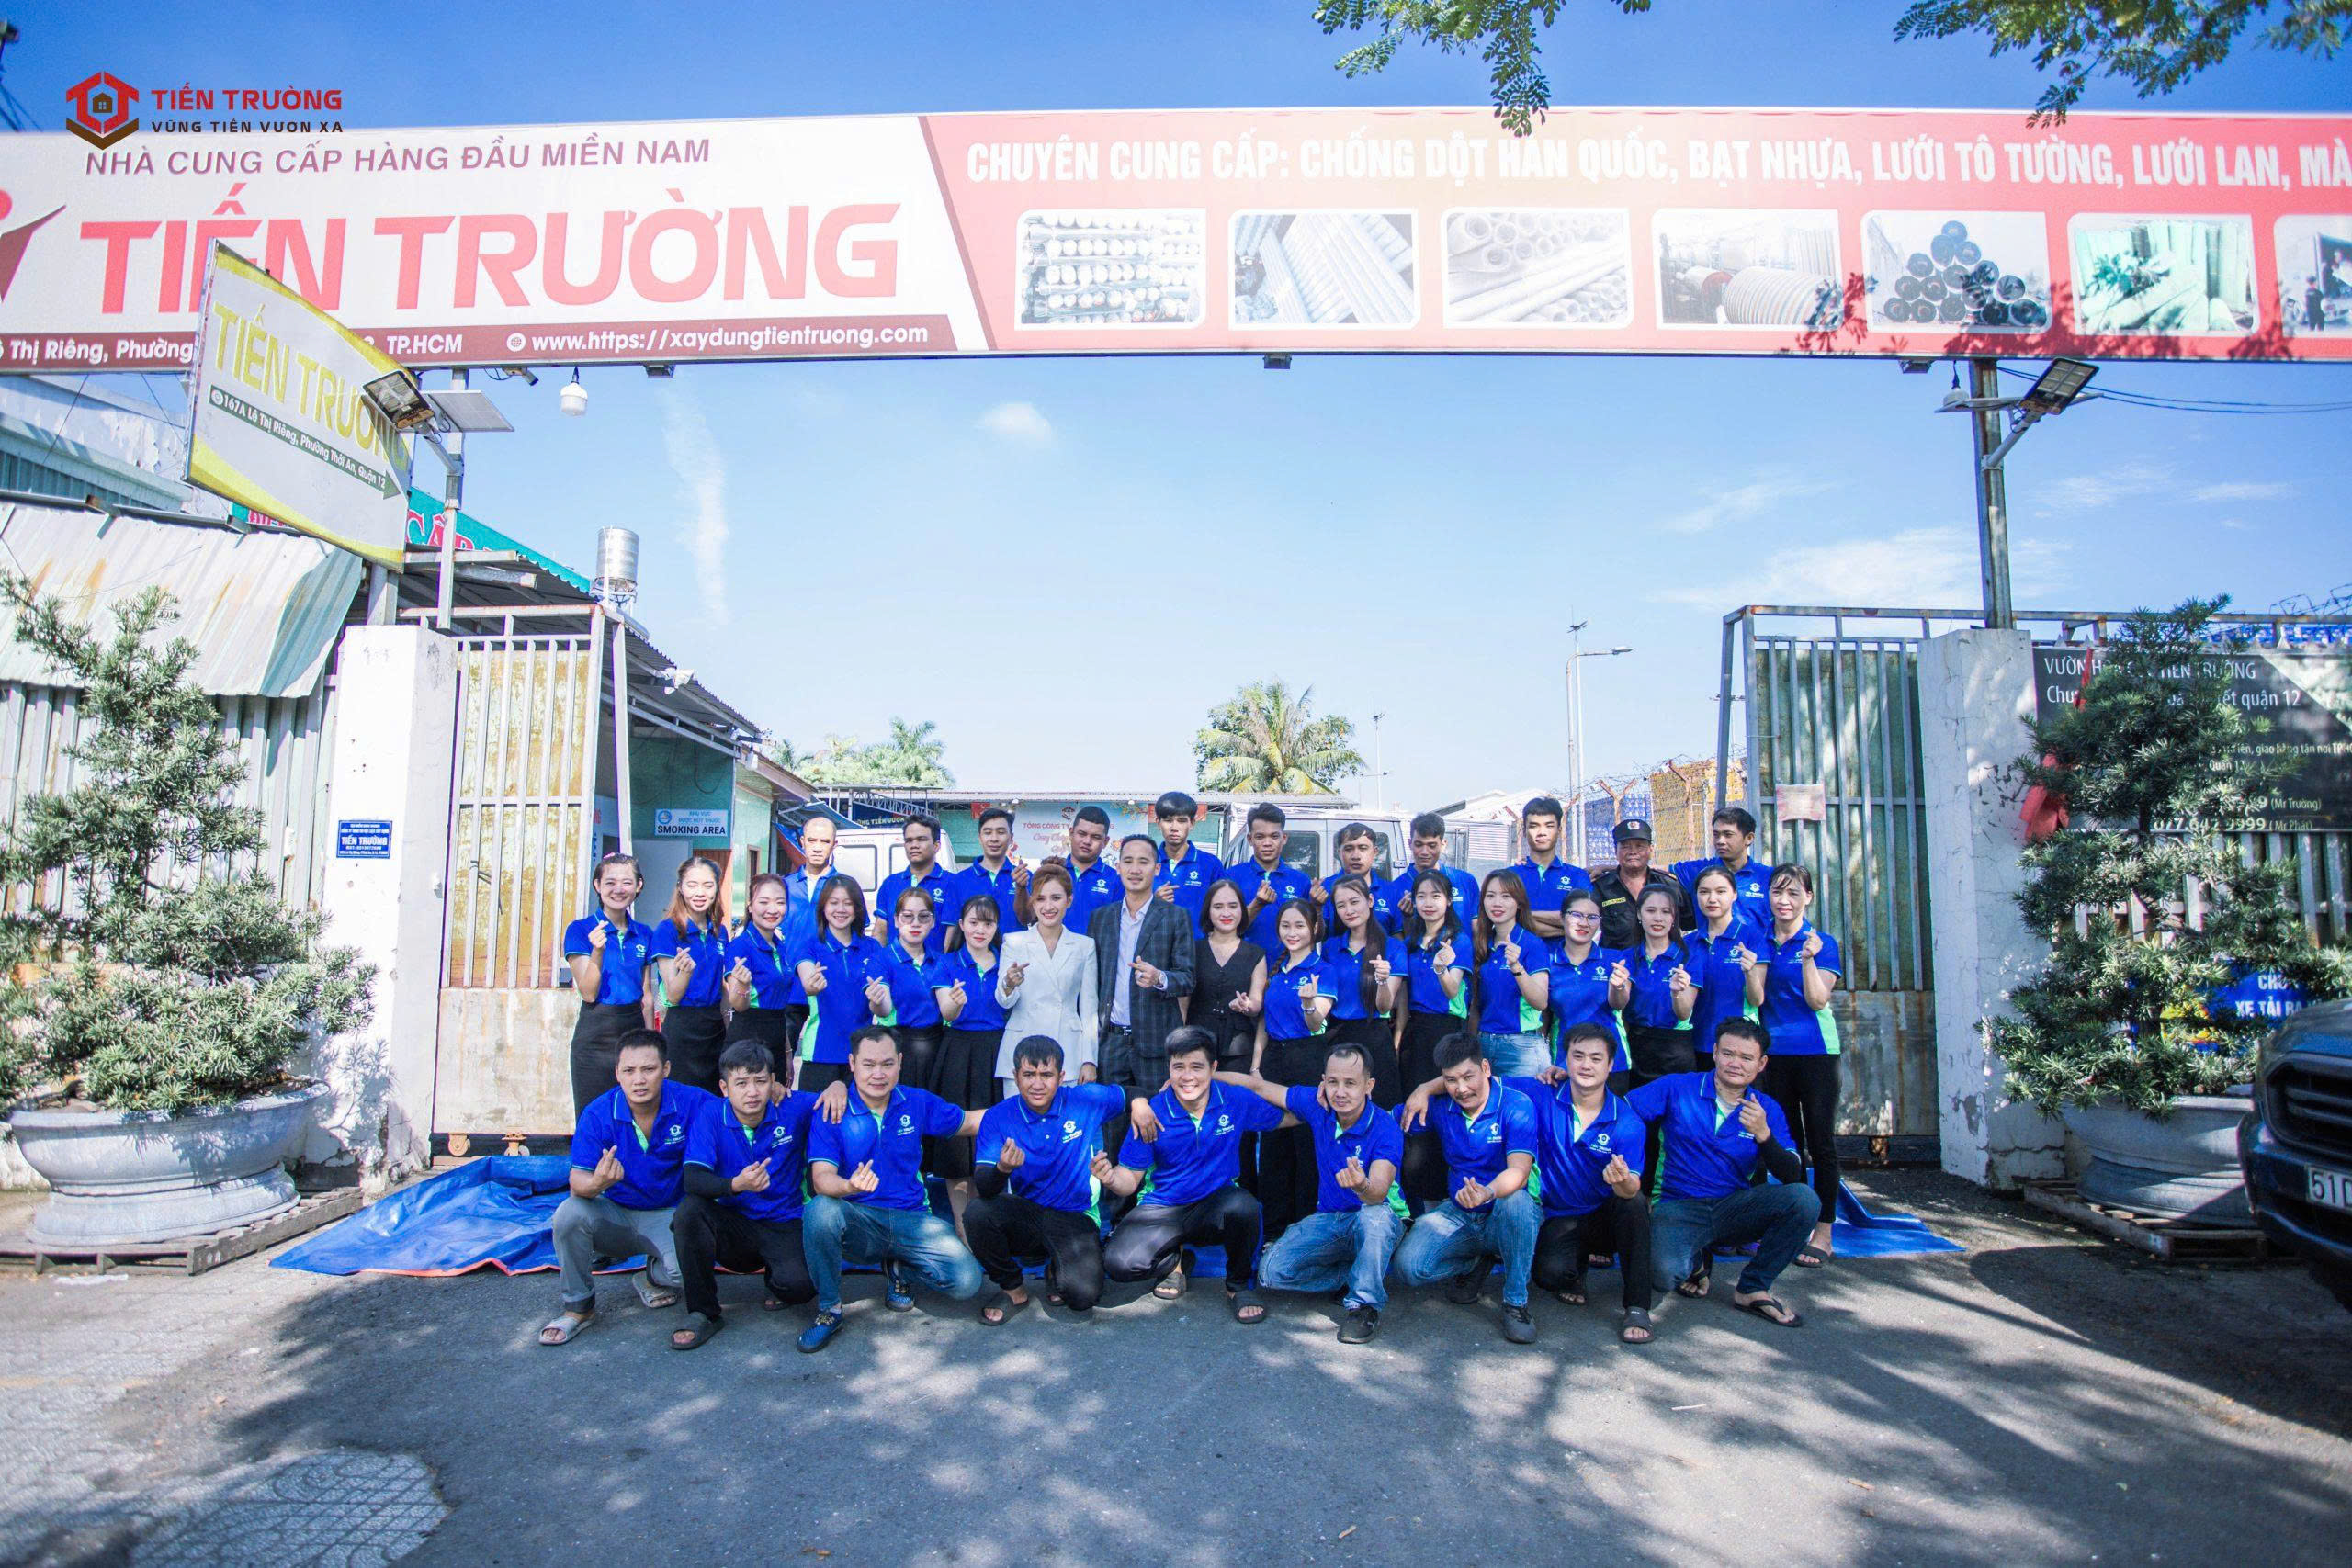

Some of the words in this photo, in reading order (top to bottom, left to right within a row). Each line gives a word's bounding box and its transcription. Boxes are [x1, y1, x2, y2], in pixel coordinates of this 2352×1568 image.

[85, 145, 154, 175] NHÀ
[167, 150, 263, 175] CUNG
[275, 140, 343, 175] CẤP
[354, 141, 449, 173] HÀNG
[461, 135, 530, 169] ĐẦU
[541, 131, 625, 167] MIỀN
[636, 139, 710, 164] NAM
[967, 133, 1099, 183] CHUYÊN
[1109, 140, 1201, 182] CUNG
[1212, 127, 1289, 181] CẤP:
[1299, 123, 1415, 179] CHỐNG
[1424, 130, 1488, 187] DỘT
[1577, 124, 1679, 185] QUỐC,
[1689, 140, 1750, 188] BẠT
[1761, 136, 1863, 189] NHỰA,
[1872, 133, 1946, 182] LƯỚI
[1954, 134, 1996, 183] TÔ
[2004, 134, 2124, 190] TƯỜNG,
[2132, 137, 2206, 186] LƯỚI
[2215, 145, 2290, 191] LAN,
[80, 182, 348, 314] TIẾN
[373, 187, 902, 310] TRƯỜNG
[10, 339, 40, 365] Thị
[45, 337, 109, 365] Riêng,
[116, 337, 194, 364] Phường
[386, 333, 463, 355] TP.HCM
[531, 322, 929, 352] www.https://xaydungtientruong.com
[213, 303, 290, 404] TIẾN
[223, 394, 246, 417] 167A
[247, 406, 258, 423] Lê
[259, 412, 273, 434] Thị
[300, 434, 330, 461] Phường
[345, 459, 357, 476] An,
[378, 475, 386, 489] 12
[2241, 690, 2278, 711] quận
[2282, 689, 2301, 706] 12
[341, 833, 358, 846] TIẾN
[358, 834, 388, 846] TRƯỜNG
[657, 825, 700, 835] SMOKING
[702, 825, 726, 835] AREA
[2258, 995, 2281, 1017] TẢI
